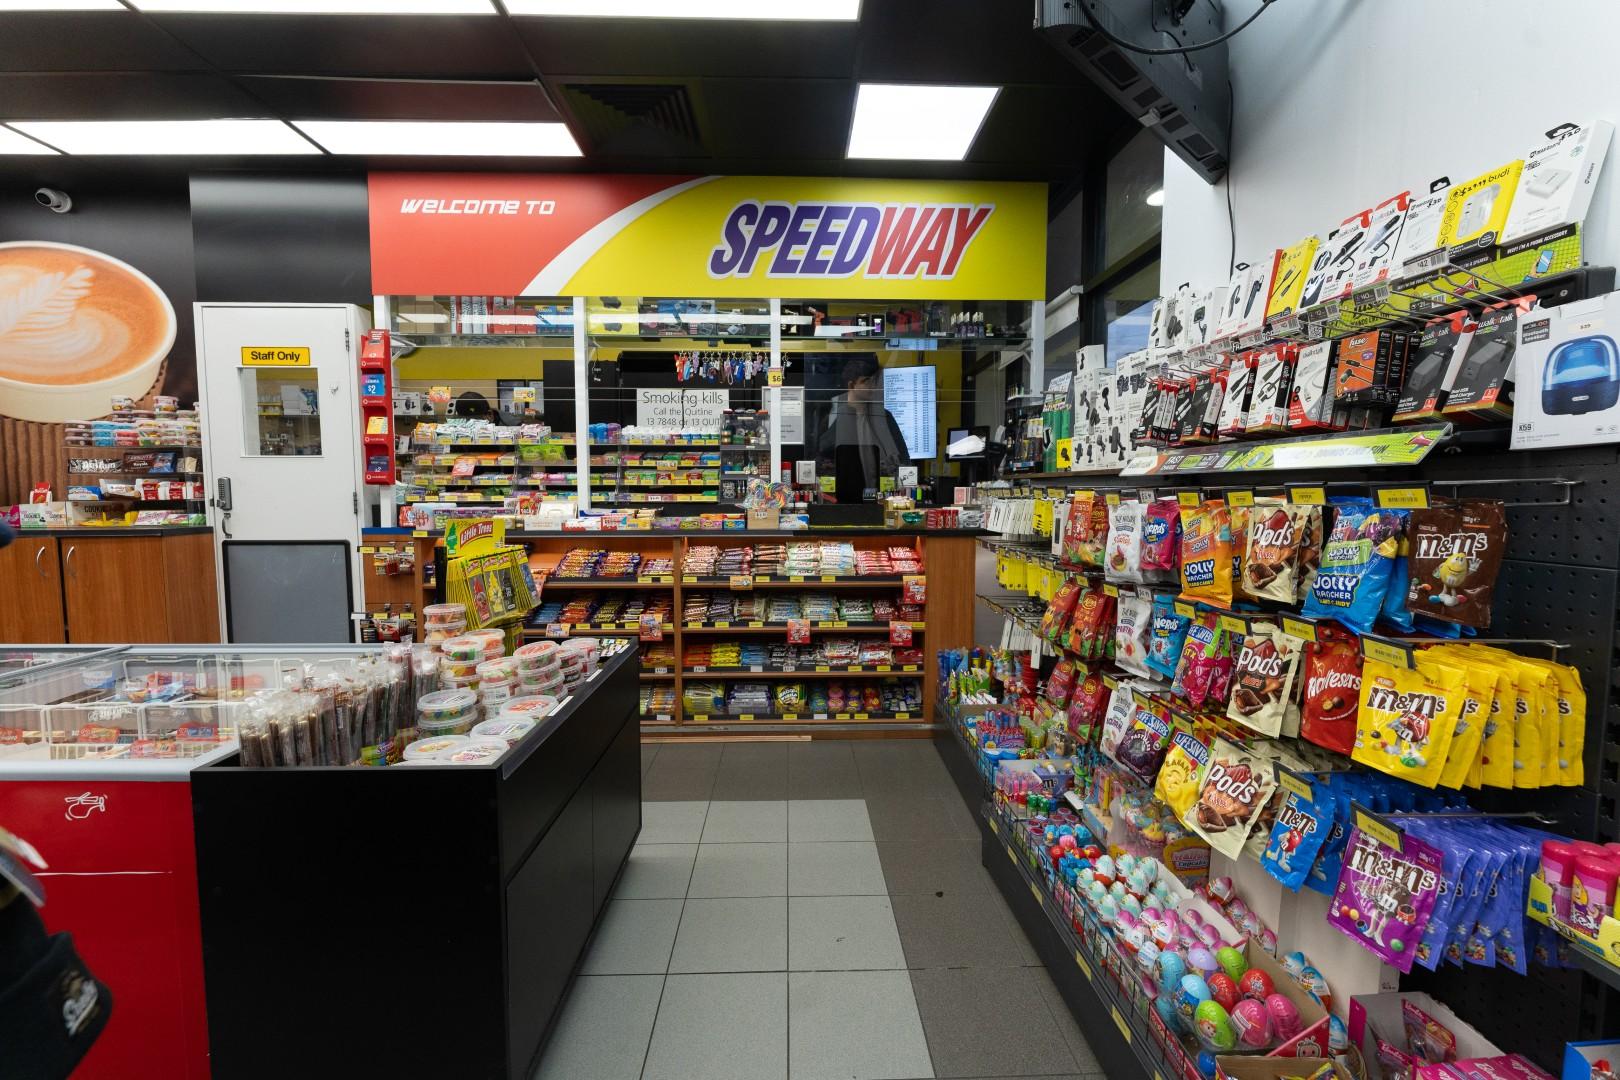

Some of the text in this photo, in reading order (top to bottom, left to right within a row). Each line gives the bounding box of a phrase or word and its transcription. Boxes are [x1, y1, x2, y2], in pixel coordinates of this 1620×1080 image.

[1488, 167, 1510, 183] budi
[525, 200, 556, 215] TO
[709, 200, 993, 277] SPEEDWAY
[251, 351, 300, 362] Staff Only
[367, 385, 376, 394] $2
[643, 391, 724, 408] Smoking kills
[653, 407, 713, 418] Call the Quitline
[647, 417, 655, 426] 13
[656, 417, 677, 426] 7848
[691, 418, 700, 426] 13
[1168, 455, 1185, 465] FAST
[460, 529, 477, 543] Little
[1253, 520, 1295, 547] Pods
[1184, 560, 1214, 577] JOLLY
[1187, 573, 1213, 582] RANCHER
[1312, 576, 1357, 592] JOLLY
[1316, 590, 1352, 600] RANCHER
[1236, 647, 1282, 677] Pods
[1208, 764, 1257, 804] Pods
